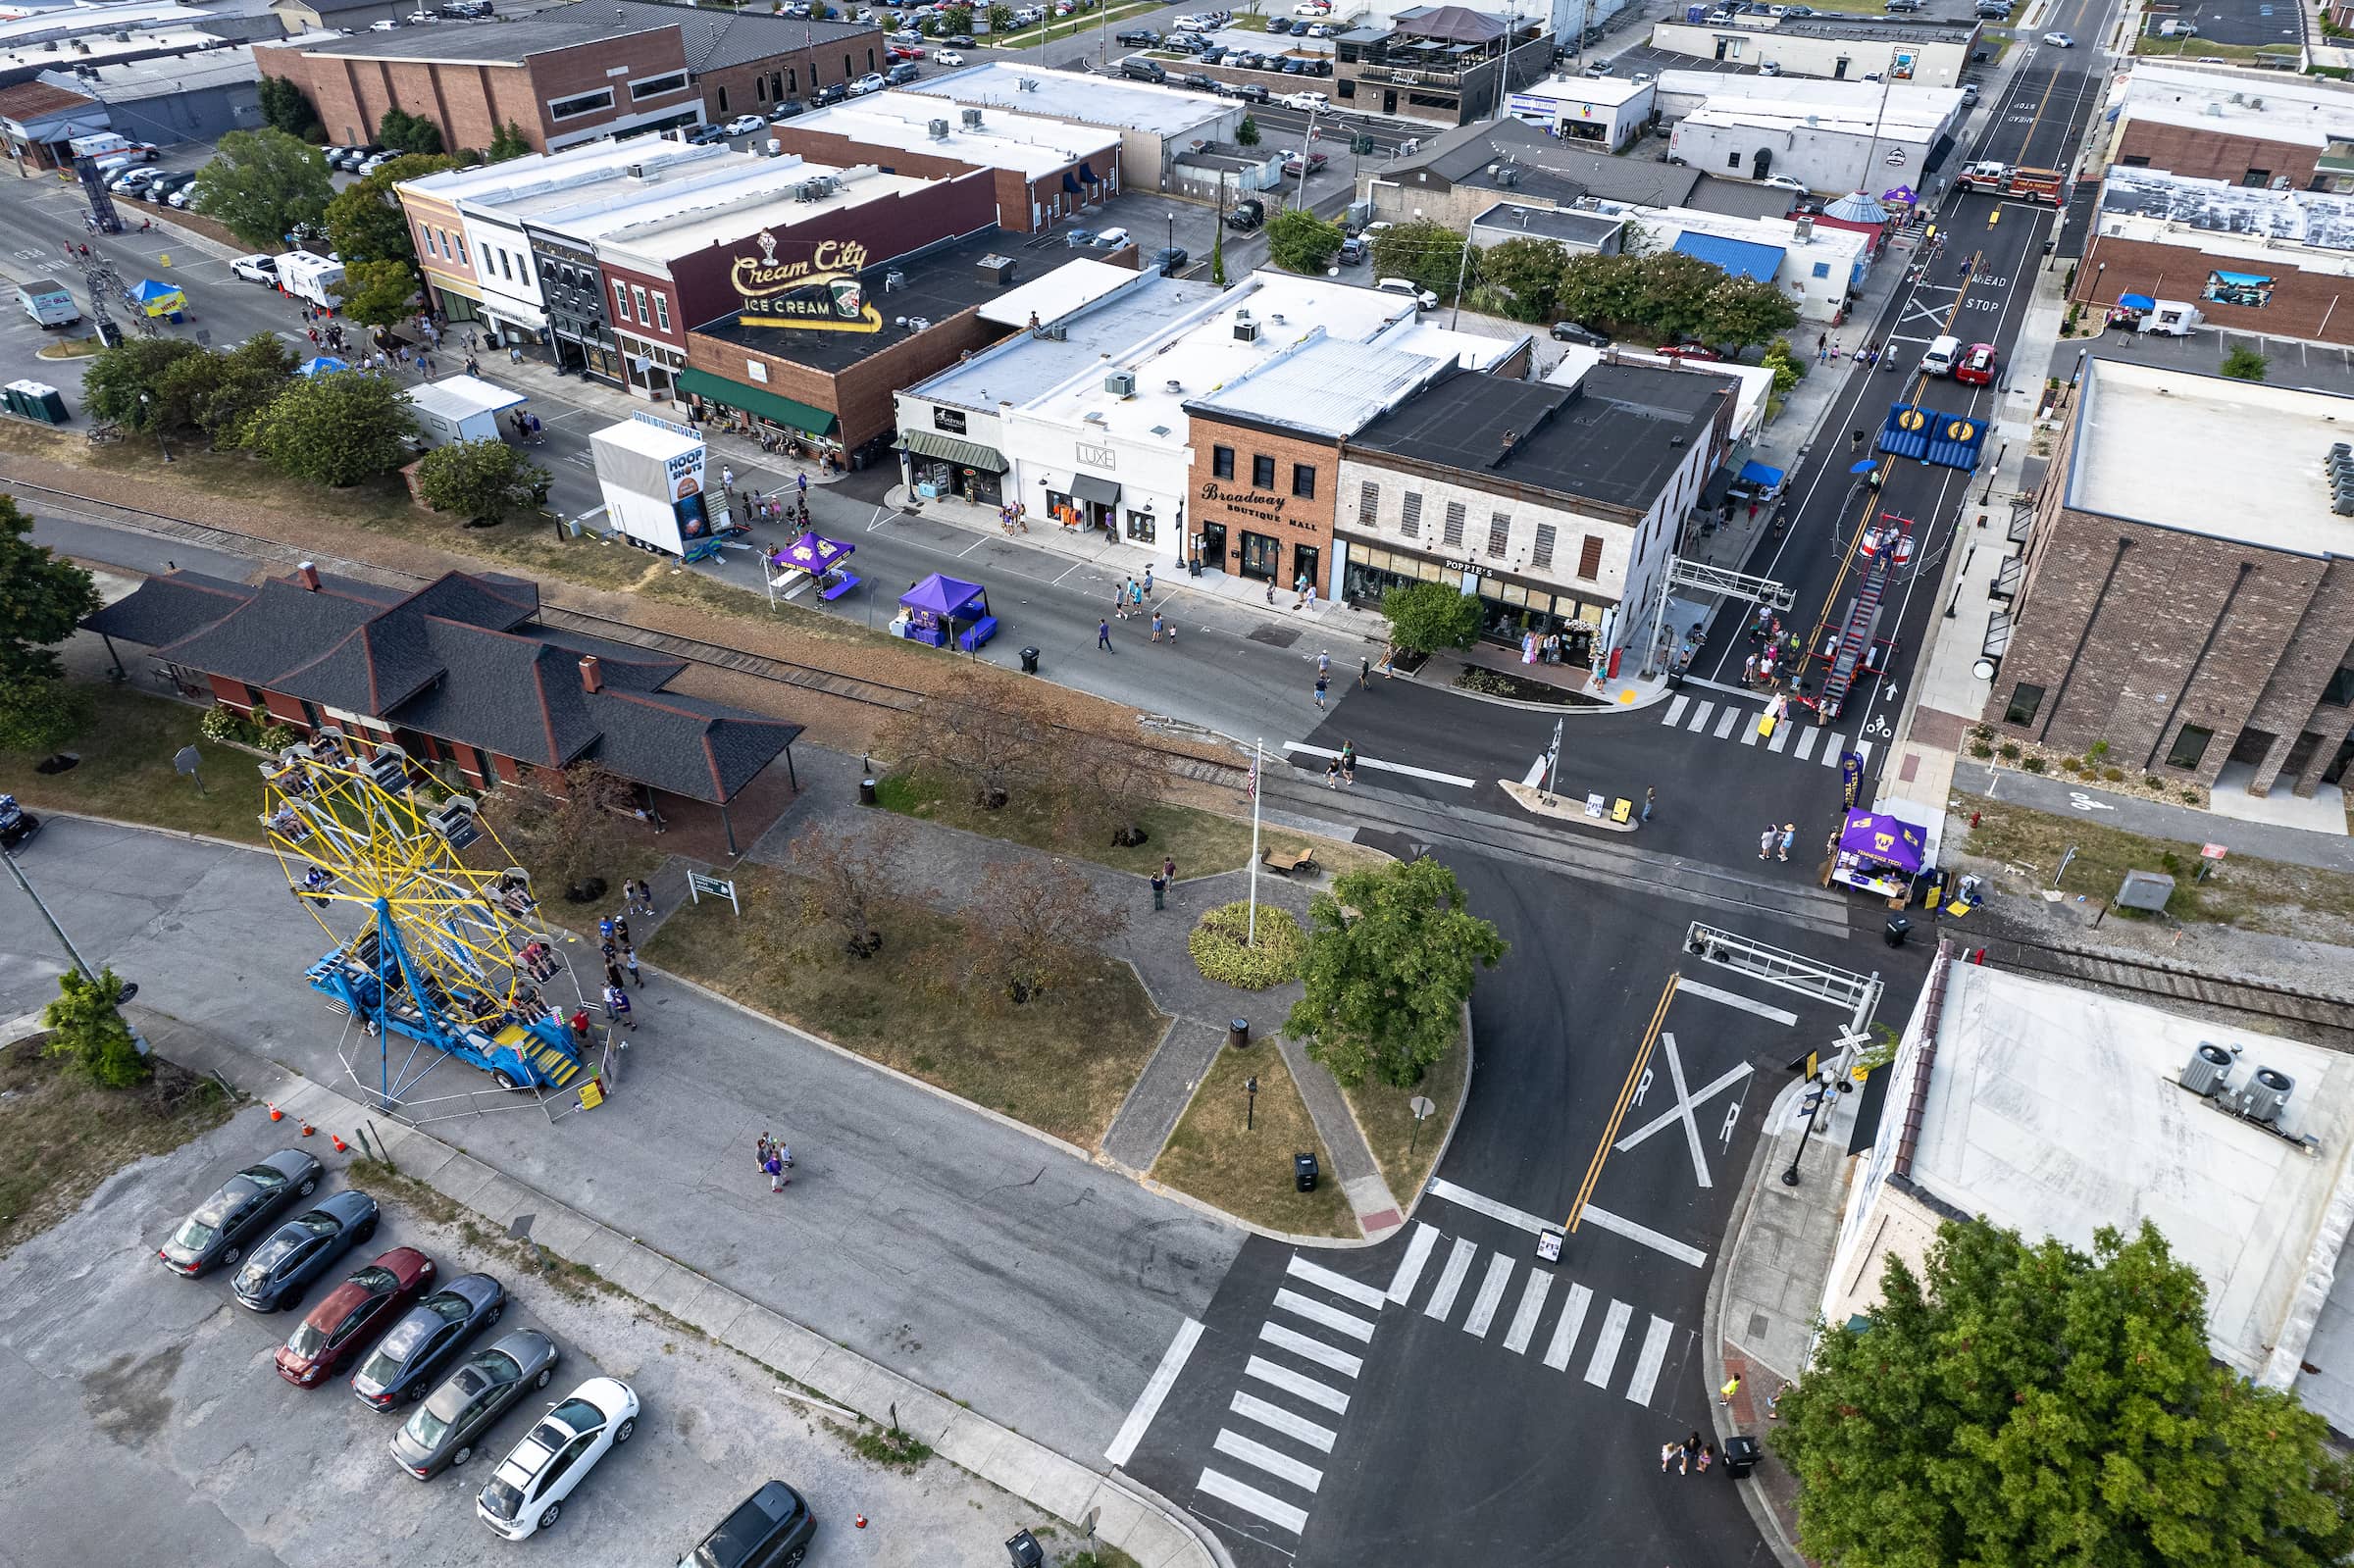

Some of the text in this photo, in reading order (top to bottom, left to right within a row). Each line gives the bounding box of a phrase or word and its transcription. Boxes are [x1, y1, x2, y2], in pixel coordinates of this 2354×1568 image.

[14, 247, 47, 260] PED
[731, 239, 868, 296] Cream City
[1970, 273, 2007, 287] AHEAD
[743, 297, 830, 315] ICE CREAM
[1966, 298, 1999, 312] STOP
[669, 449, 702, 471] HOOP
[1079, 444, 1114, 468] LUXE
[1202, 482, 1285, 511] Broadway
[1227, 504, 1318, 531] BOUTIQUE MALL
[1446, 560, 1493, 577] POPPIE'S
[1631, 1067, 1655, 1107] R
[1718, 1101, 1741, 1143] R
